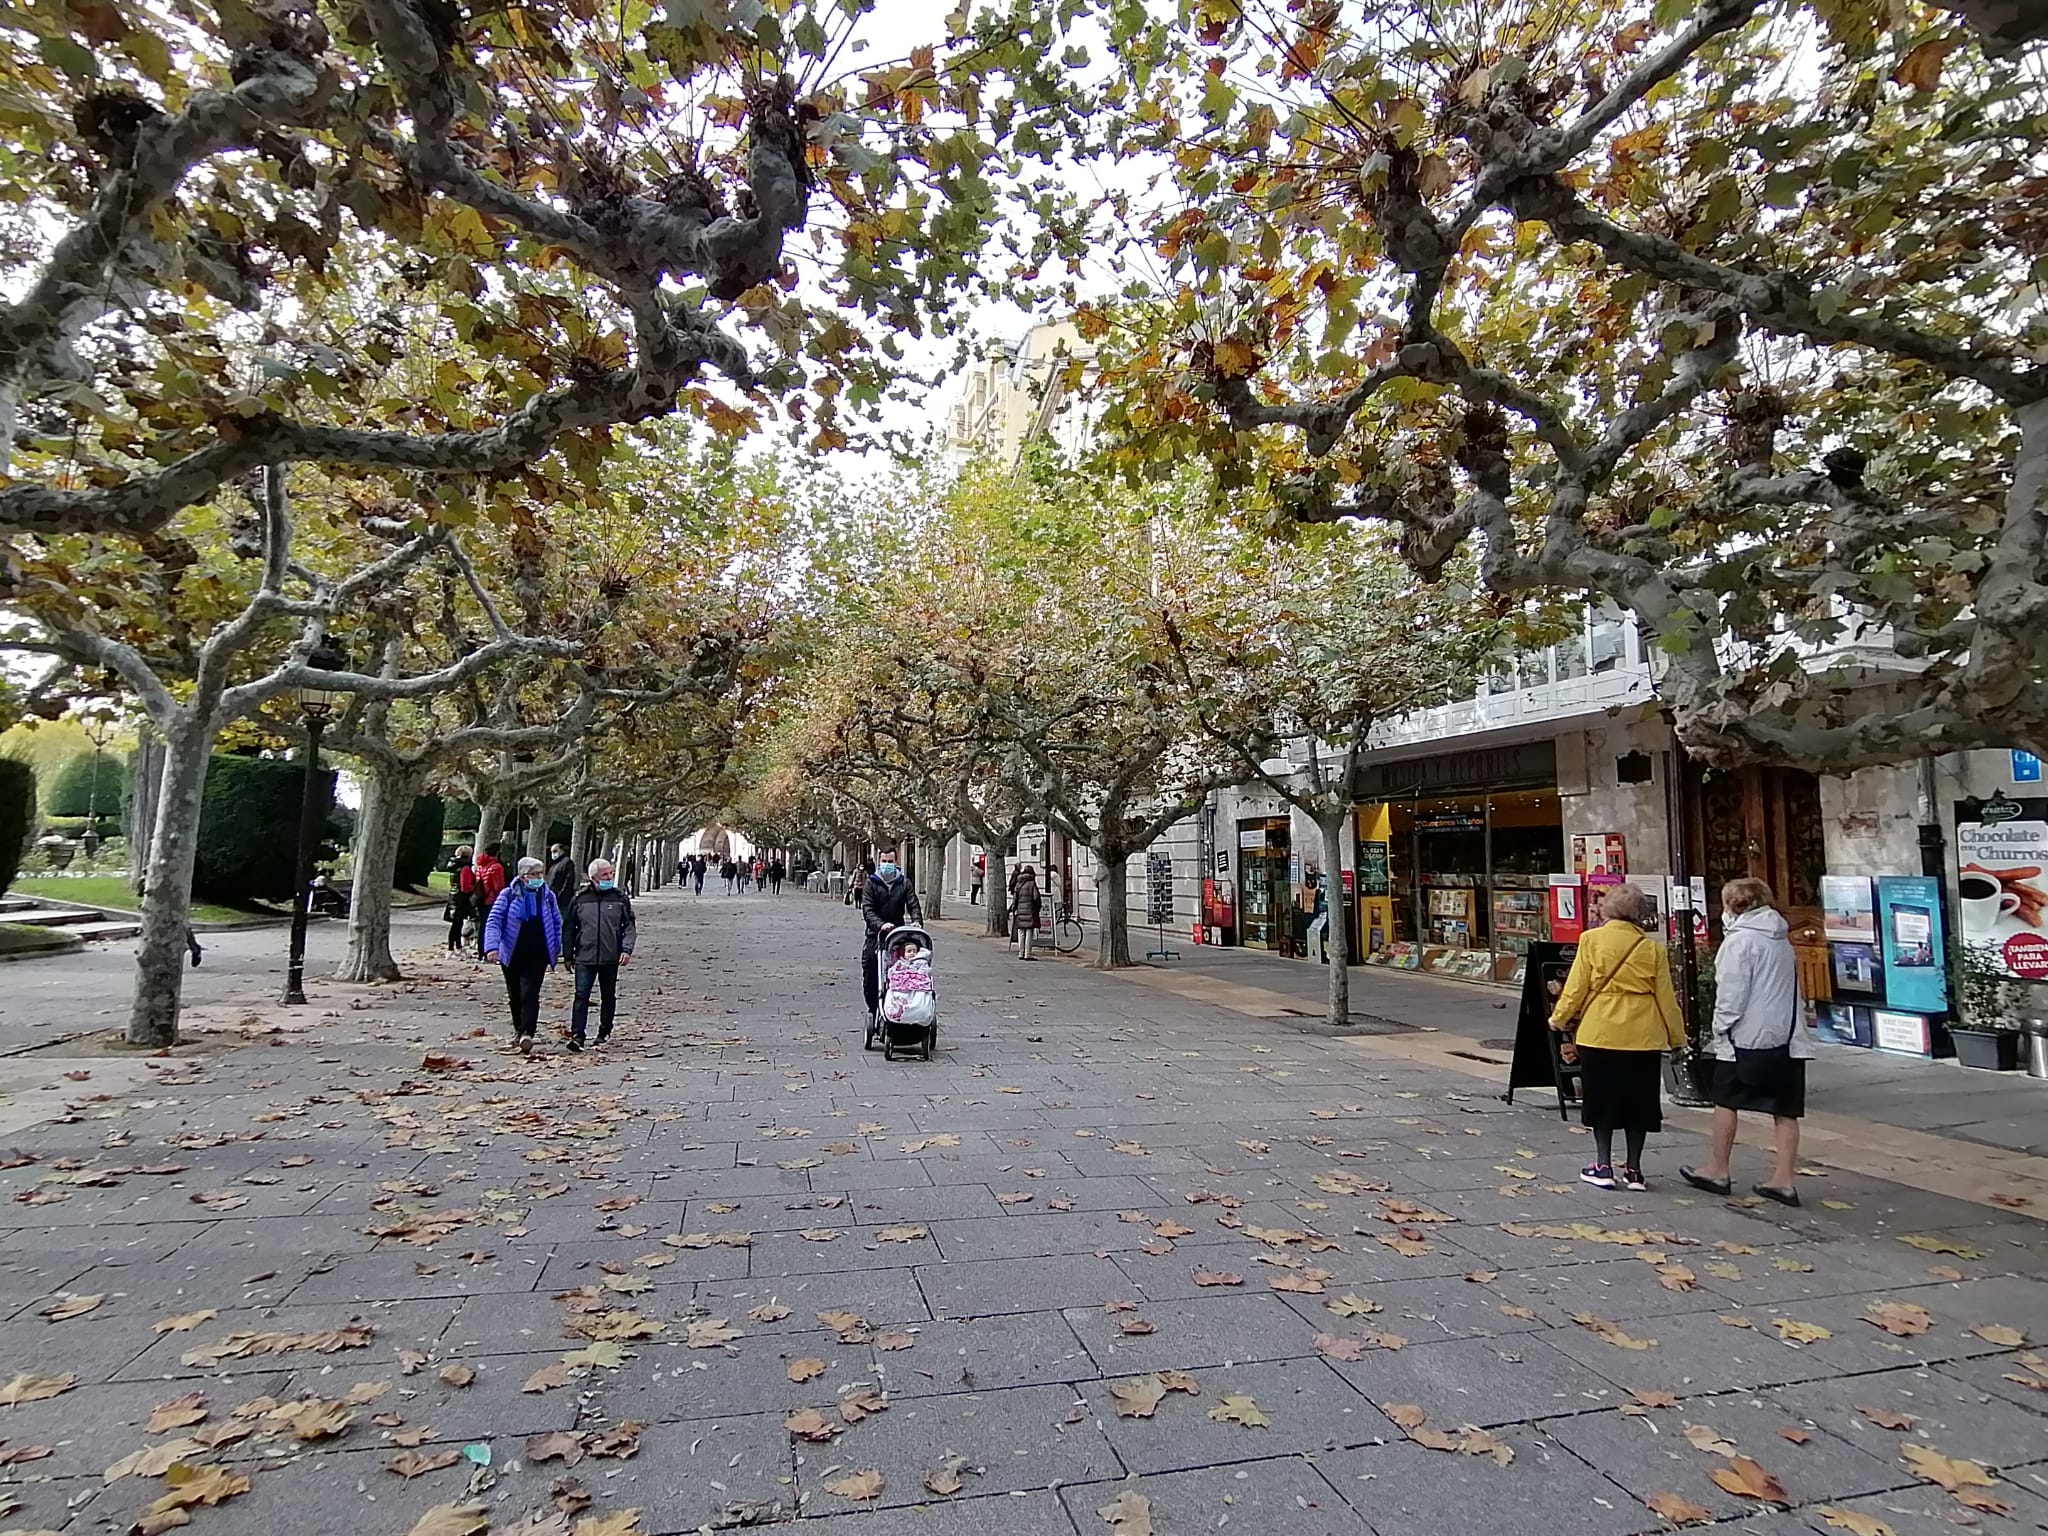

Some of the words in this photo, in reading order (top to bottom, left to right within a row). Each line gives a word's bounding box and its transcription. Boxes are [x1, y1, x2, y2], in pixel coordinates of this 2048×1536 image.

[1467, 817, 1485, 825] años
[1960, 828, 2040, 843] Chocolate
[1977, 846, 2048, 860] Churros
[2017, 952, 2043, 961] PARA
